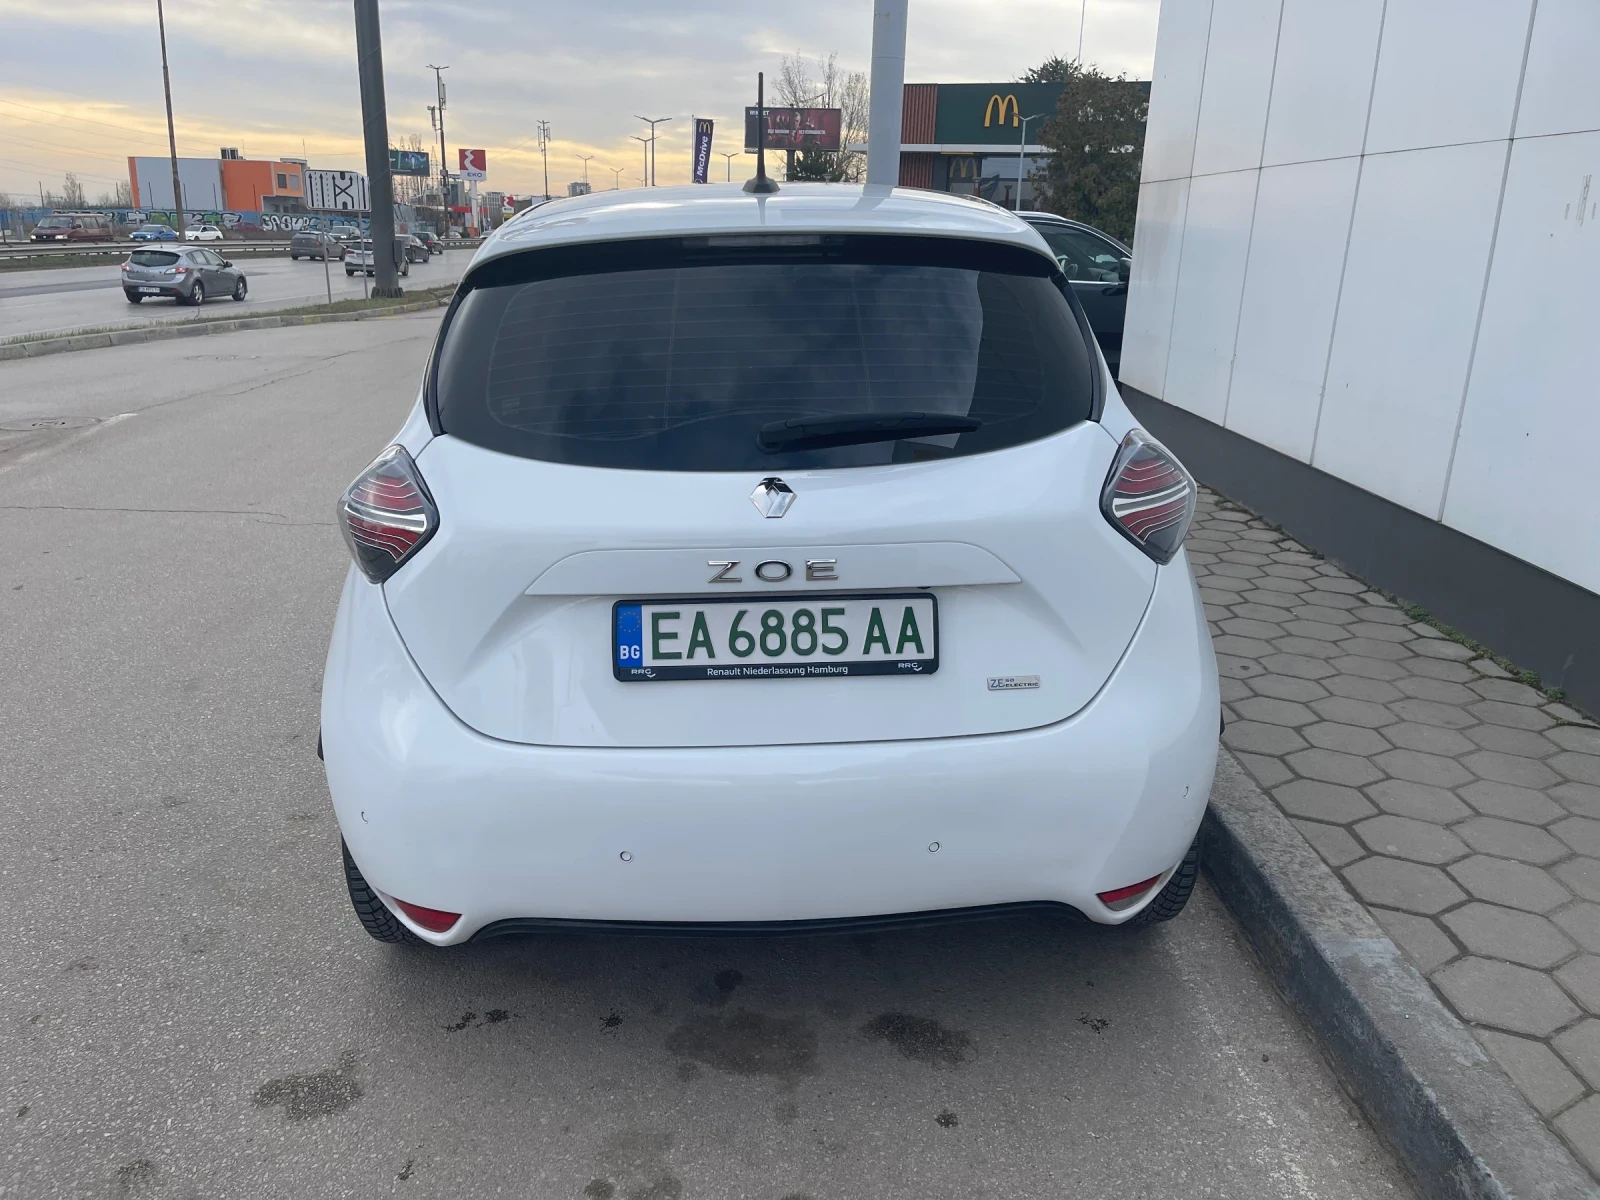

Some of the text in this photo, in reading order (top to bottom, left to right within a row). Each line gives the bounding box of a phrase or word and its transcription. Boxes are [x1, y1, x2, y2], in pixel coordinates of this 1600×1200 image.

[697, 135, 709, 176] McDrive
[707, 558, 839, 583] ZOE
[651, 606, 924, 660] EA 6885 AA
[620, 645, 640, 660] BG
[707, 665, 848, 677] Renault Niederlassung Hamburg
